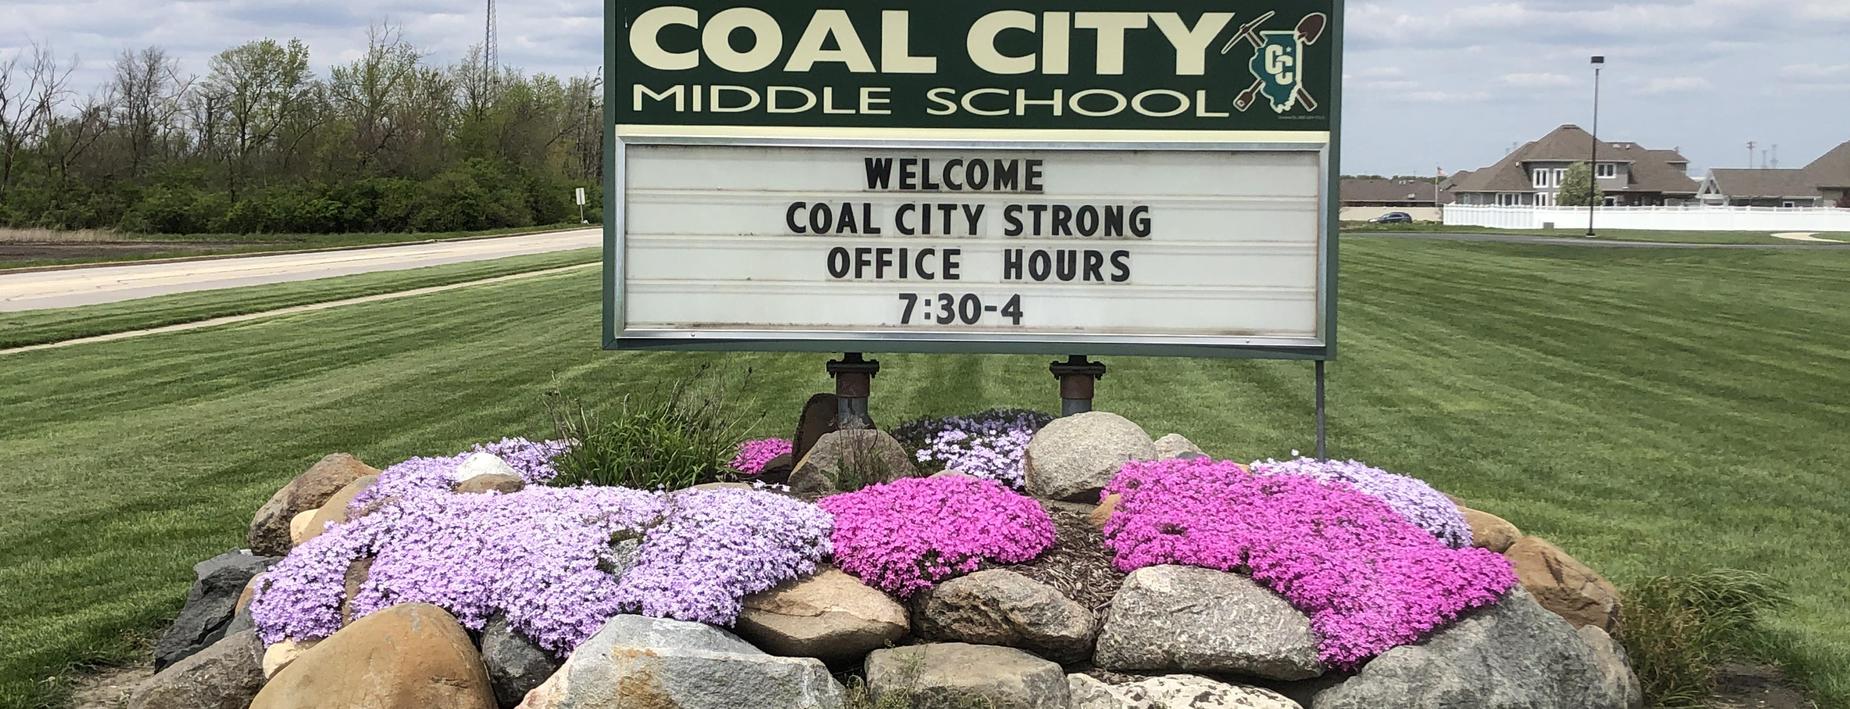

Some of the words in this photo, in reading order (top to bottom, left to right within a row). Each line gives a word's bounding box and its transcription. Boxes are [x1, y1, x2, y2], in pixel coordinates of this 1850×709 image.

[629, 6, 937, 74] COAL
[965, 11, 1235, 76] CITY
[632, 84, 891, 114] MIDDLE
[926, 88, 1229, 118] SCHOOL
[865, 157, 1043, 192] WELCOME
[786, 202, 880, 236] COAL
[895, 203, 984, 236] CITY
[1004, 204, 1152, 238] STRONG
[827, 246, 960, 280] OFFICE
[1004, 249, 1131, 283] HOURS
[899, 293, 1023, 326] 7:30-4
